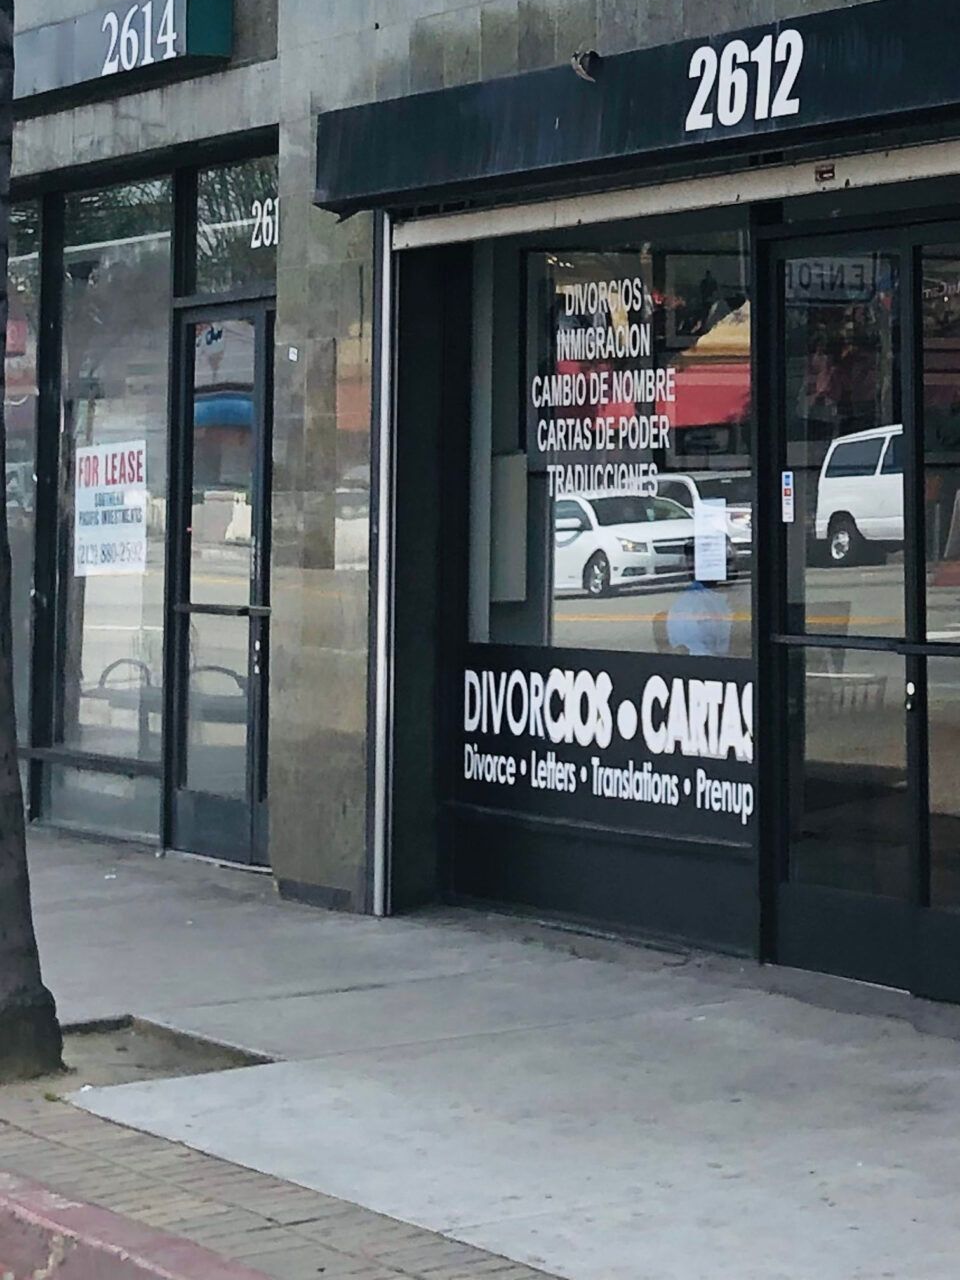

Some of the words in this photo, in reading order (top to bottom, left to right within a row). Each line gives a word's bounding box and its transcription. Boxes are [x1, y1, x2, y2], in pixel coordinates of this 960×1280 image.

[685, 29, 803, 132] 2612
[564, 277, 642, 316] DIVORCIOS
[556, 324, 651, 361] INMIGRACION
[532, 373, 586, 407] CAMBIO
[590, 371, 609, 404] DE
[612, 368, 676, 403] NOMBRE
[537, 418, 592, 452] CARTAS
[595, 417, 615, 450] DE
[618, 416, 670, 449] PODER
[79, 455, 99, 488] FOR
[105, 451, 143, 486] LEASE
[547, 463, 658, 497] TRADUCCIONES
[464, 668, 613, 749] DIVORCIOS
[464, 743, 516, 785] Divorce
[530, 750, 576, 793] Letters
[591, 757, 679, 806] Translations
[696, 768, 753, 825] Prenup
